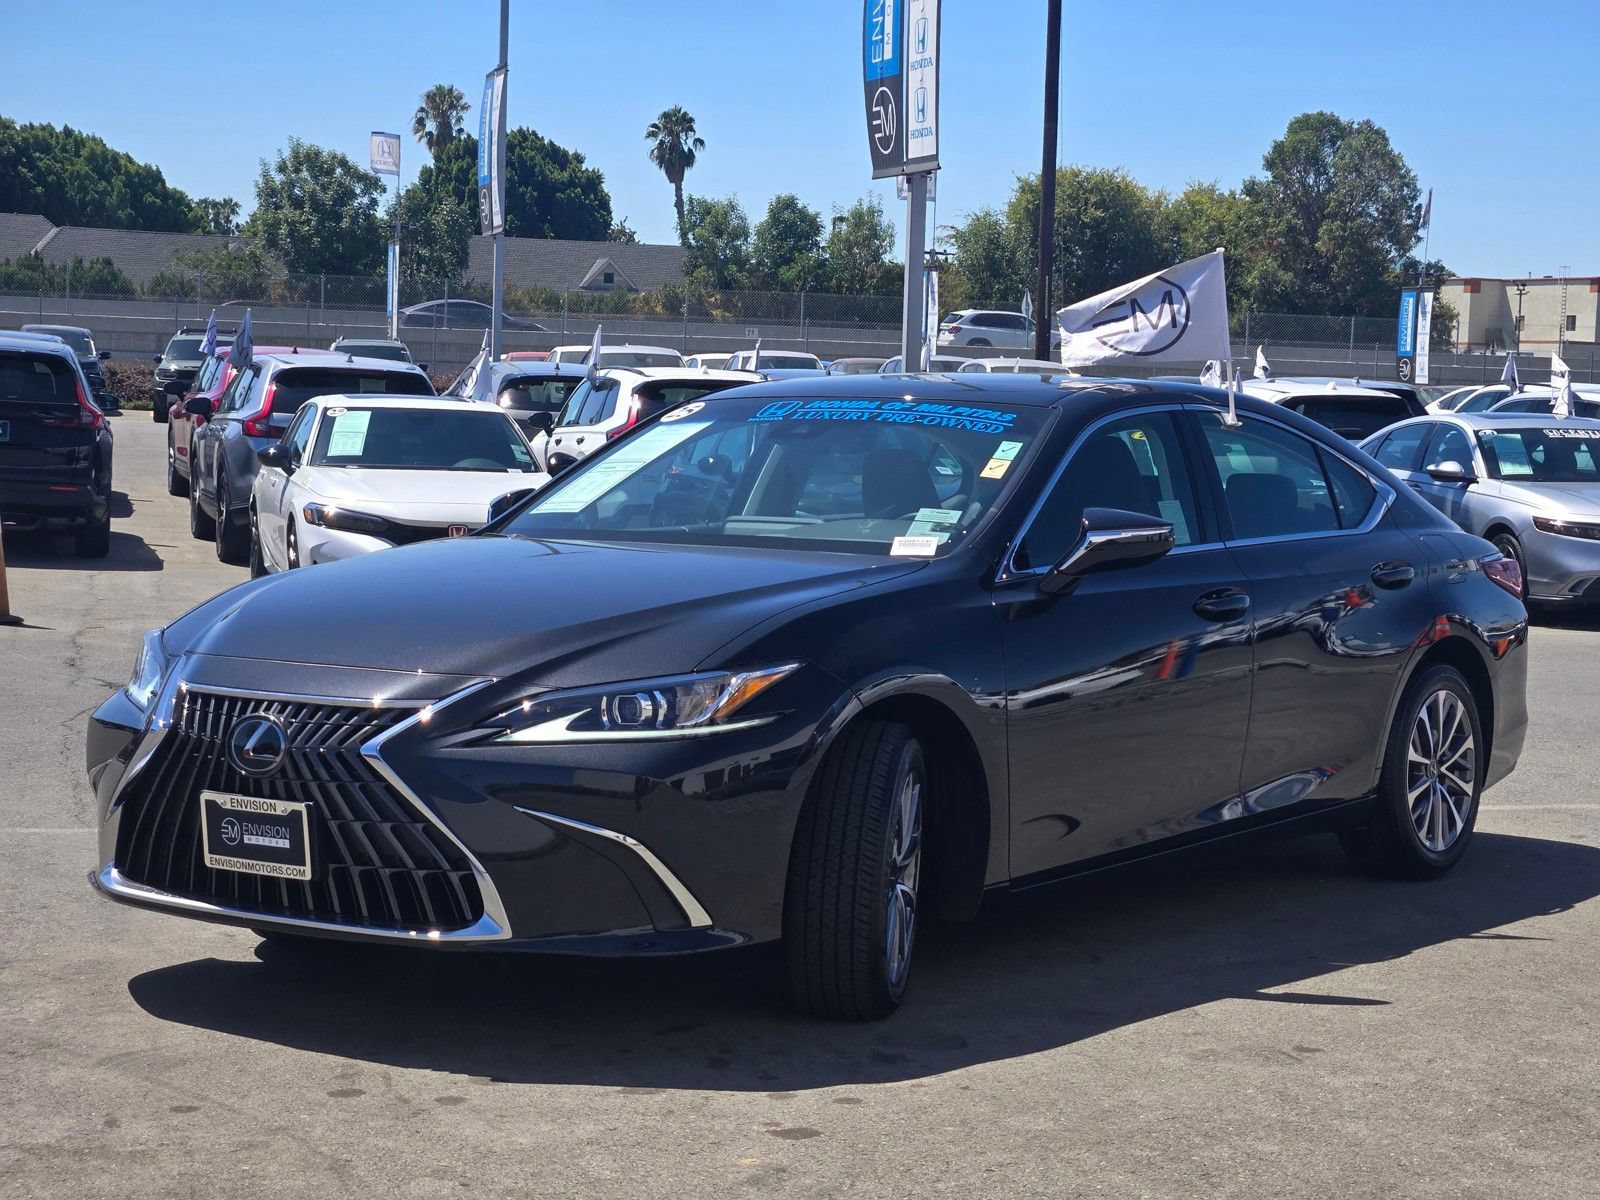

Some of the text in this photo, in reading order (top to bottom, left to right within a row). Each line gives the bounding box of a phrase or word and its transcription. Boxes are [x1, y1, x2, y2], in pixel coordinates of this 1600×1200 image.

[910, 56, 934, 71] HONDA
[910, 126, 934, 140] HONDA
[1401, 297, 1410, 352] ENVISION
[804, 400, 1017, 421] HONDA OF MILPITAS
[790, 411, 1005, 434] LUXURY PRE-OWNED
[229, 797, 277, 813] ENVISION
[242, 822, 290, 839] ENVISION
[247, 837, 287, 847] MOTORS
[209, 856, 307, 878] ENVISIONMOTORS.COM
